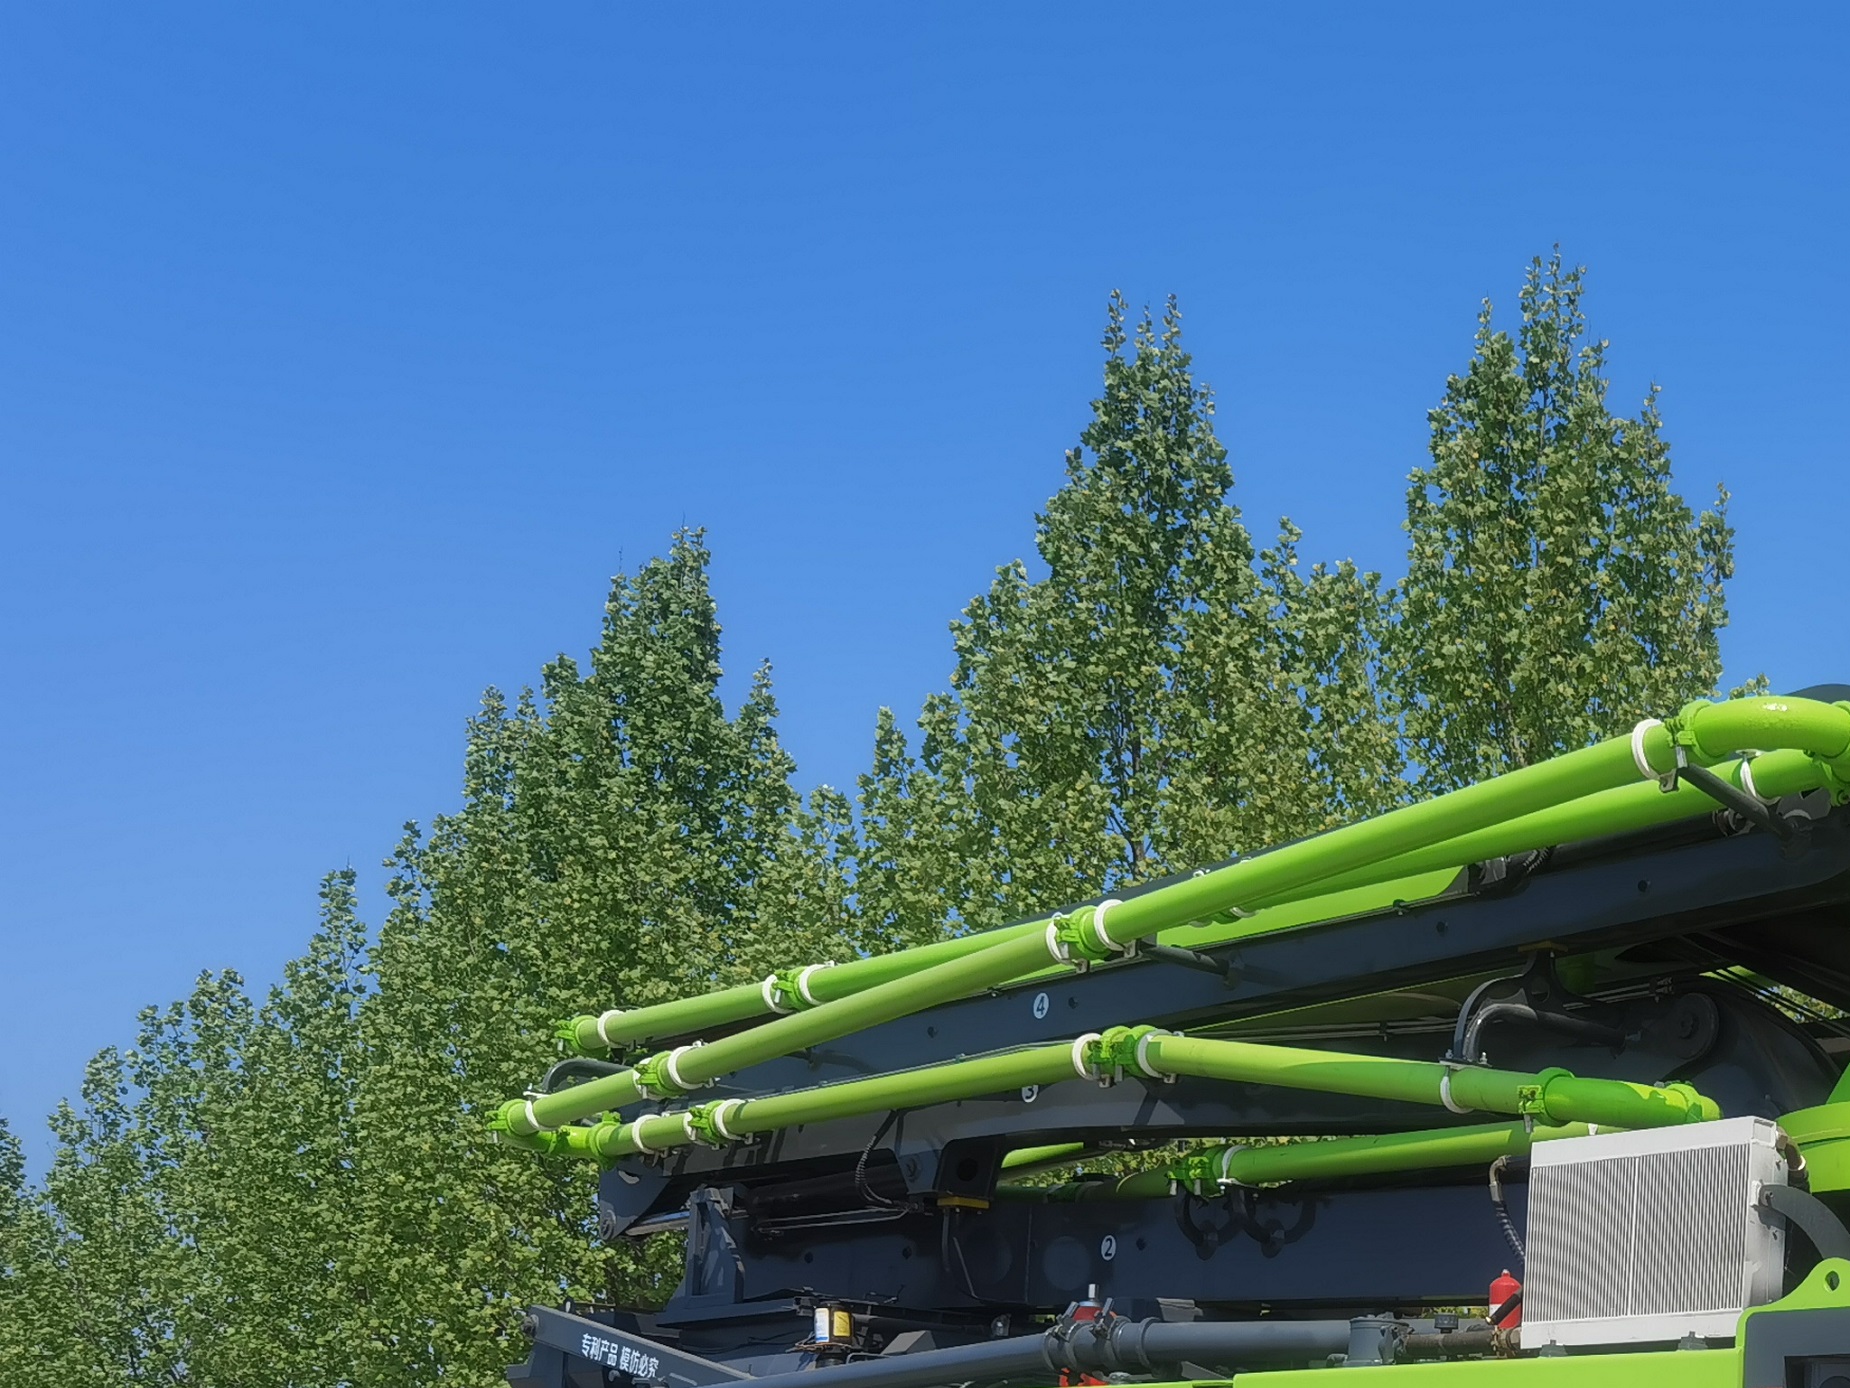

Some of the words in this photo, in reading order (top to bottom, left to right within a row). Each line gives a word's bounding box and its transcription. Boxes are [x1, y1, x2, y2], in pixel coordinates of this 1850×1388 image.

[582, 1333, 618, 1367] 专利产品
[619, 1346, 659, 1378] 模仿必究
